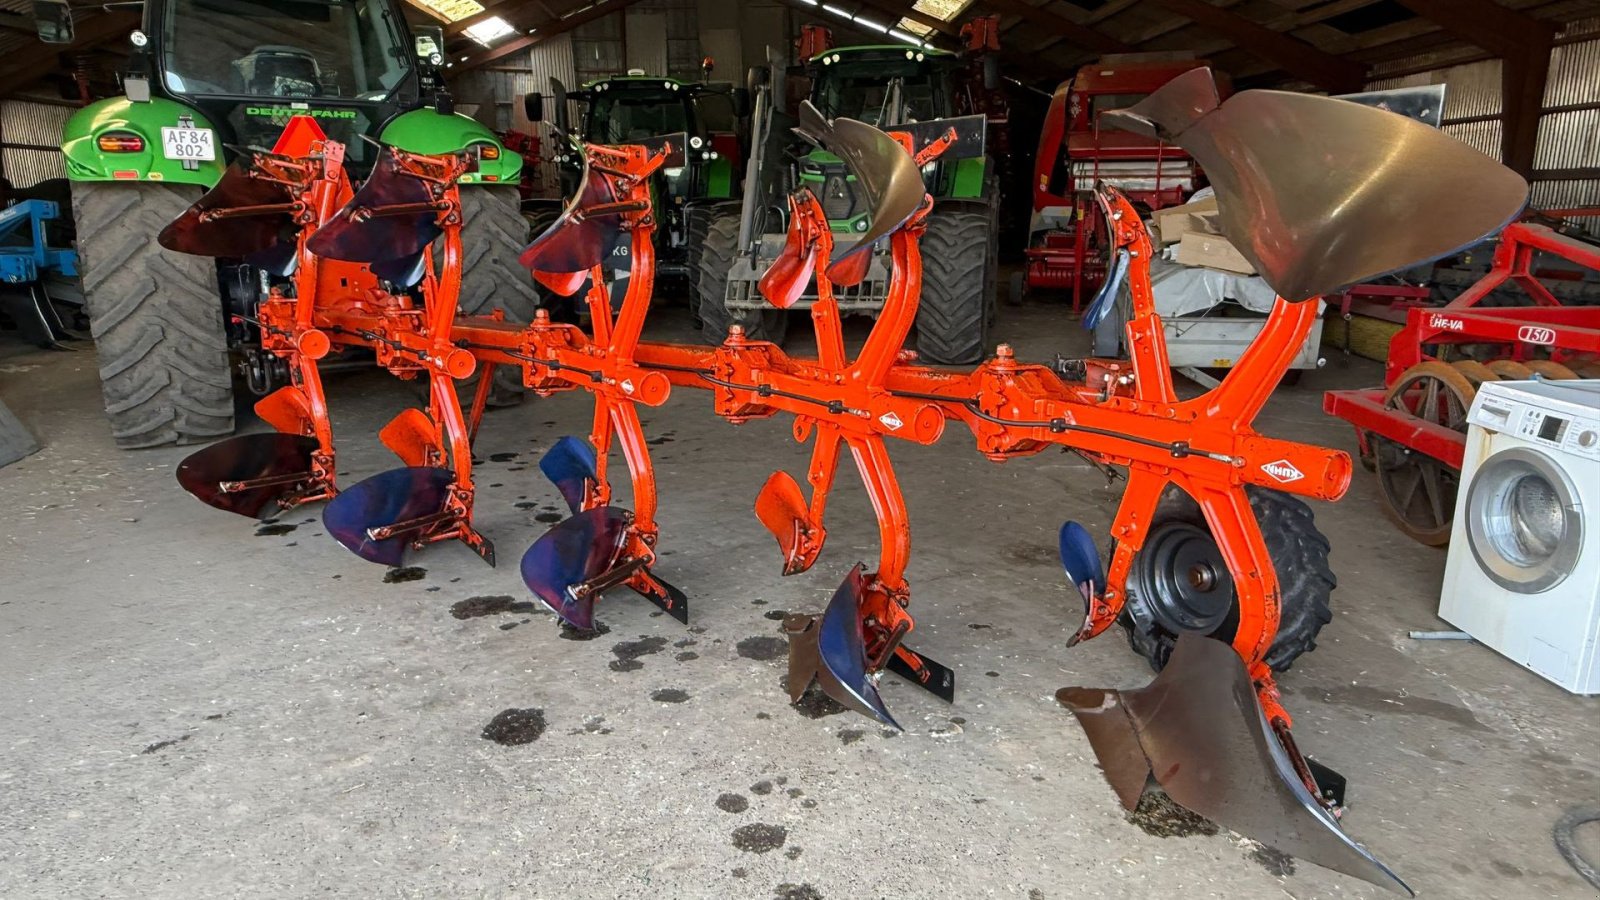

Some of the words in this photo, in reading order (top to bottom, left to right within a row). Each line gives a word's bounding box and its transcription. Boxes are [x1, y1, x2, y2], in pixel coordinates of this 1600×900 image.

[246, 107, 356, 118] DEUTZ-FAHR
[176, 143, 203, 157] 802
[612, 246, 628, 256] KG
[1434, 318, 1463, 330] HE-VA
[1526, 328, 1549, 342] 150
